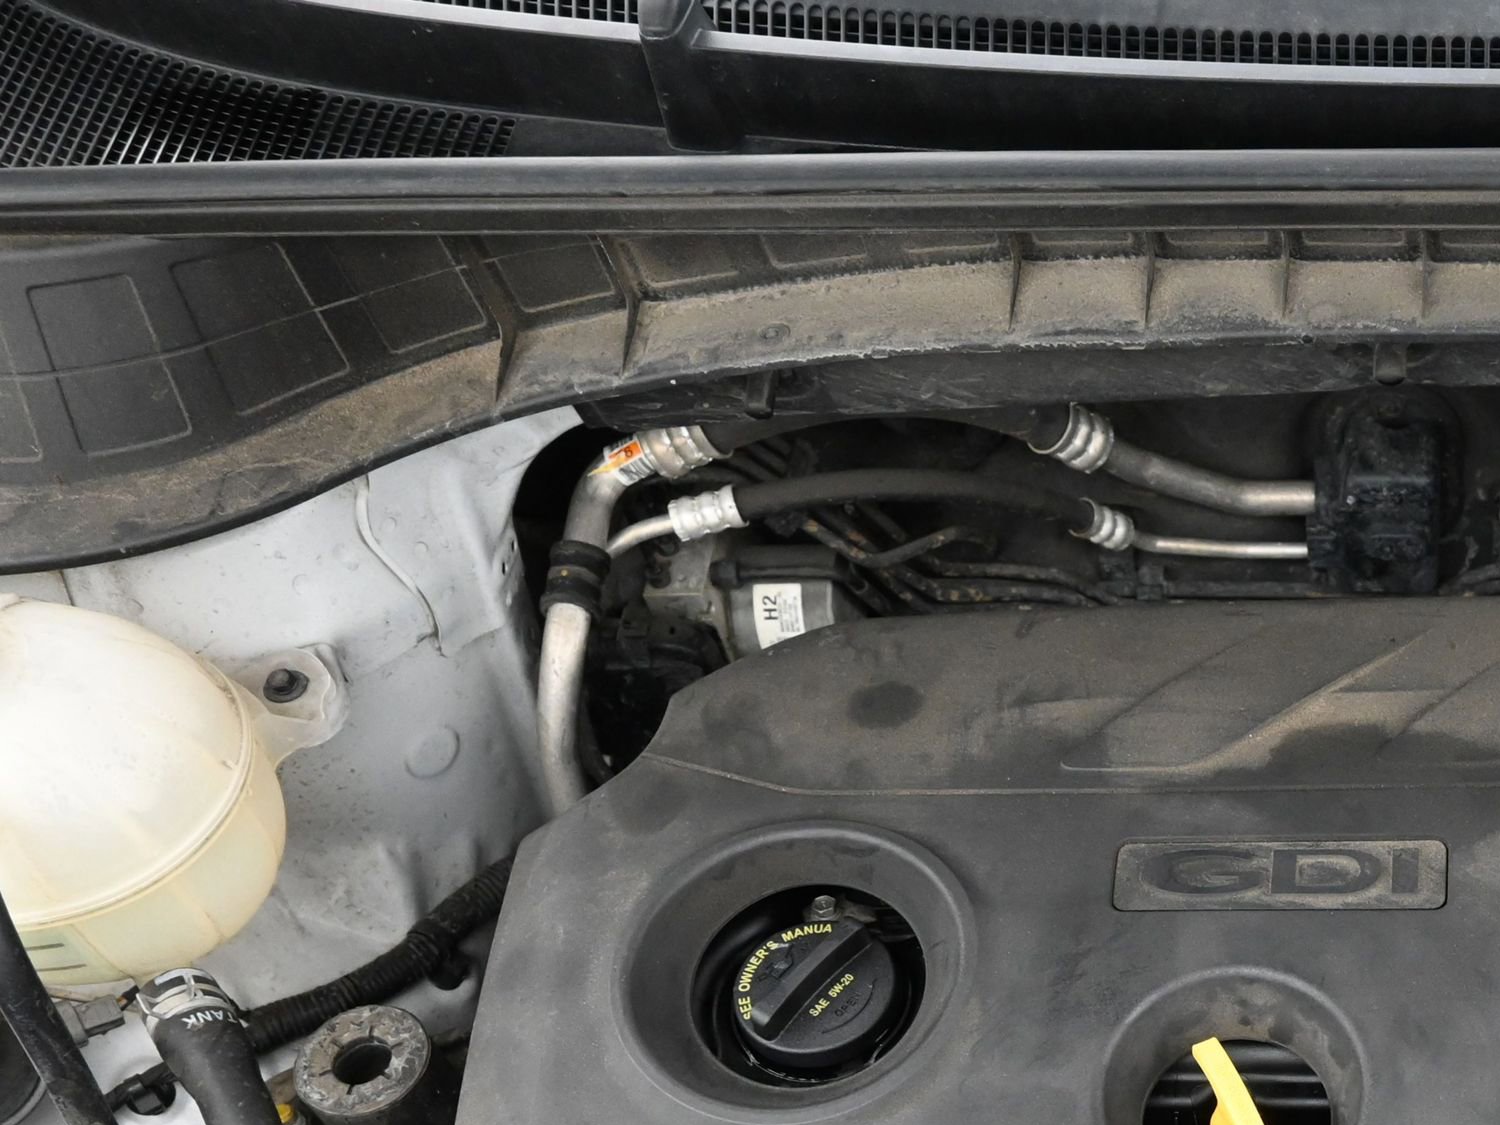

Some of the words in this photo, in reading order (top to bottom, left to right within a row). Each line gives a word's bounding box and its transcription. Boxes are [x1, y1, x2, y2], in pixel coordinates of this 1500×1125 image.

[762, 595, 779, 621] H2
[1142, 848, 1420, 893] GDI
[738, 940, 781, 993] OWNER'S
[738, 996, 753, 1021] SEE
[808, 997, 831, 1018] SAE
[827, 973, 855, 998] 5W-20
[181, 1010, 239, 1030] TANK
